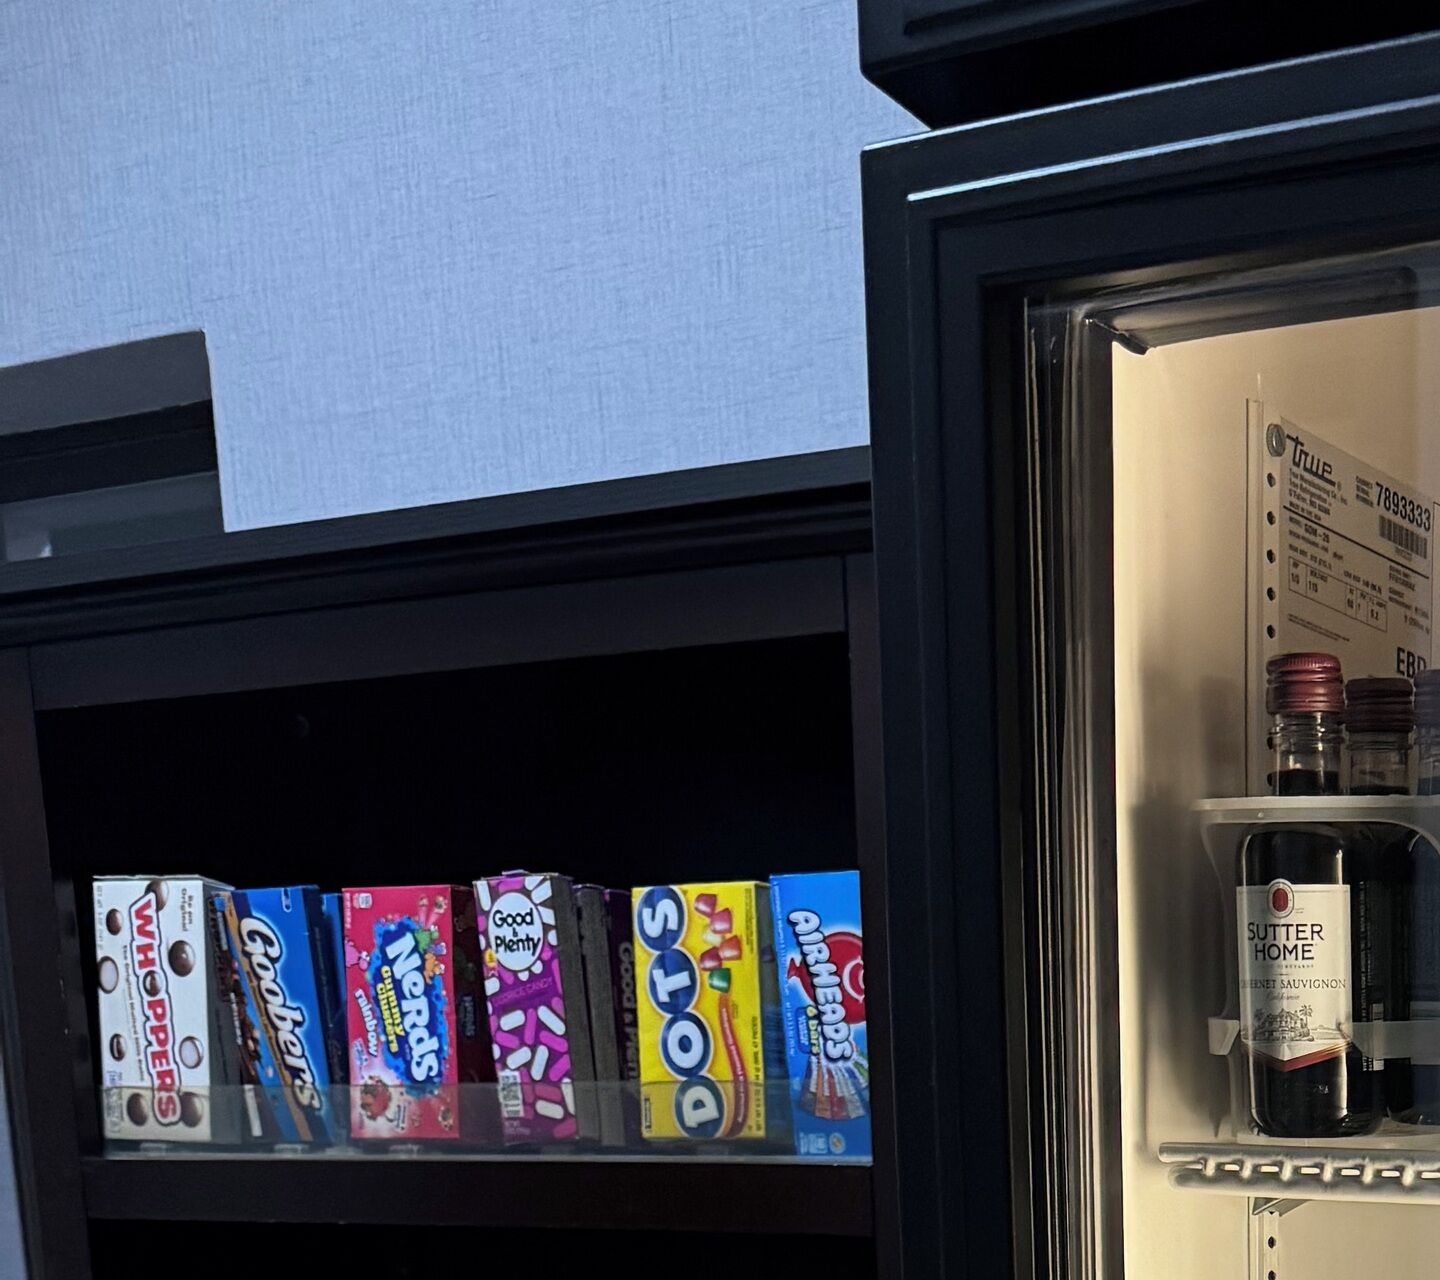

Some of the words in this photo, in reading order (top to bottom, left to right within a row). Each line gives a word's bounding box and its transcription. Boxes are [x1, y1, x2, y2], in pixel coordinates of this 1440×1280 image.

[1376, 481, 1432, 532] 7893333
[492, 909, 534, 929] Good
[1247, 922, 1325, 942] SUTTER
[495, 935, 541, 955] Plenty
[1254, 942, 1315, 961] HOME
[788, 910, 853, 1060] AIRHEADS
[1280, 978, 1346, 989] SAUVIGNON
[239, 916, 323, 1111] Goobers
[354, 988, 379, 1057] rainbow
[642, 898, 721, 1129] DOTS
